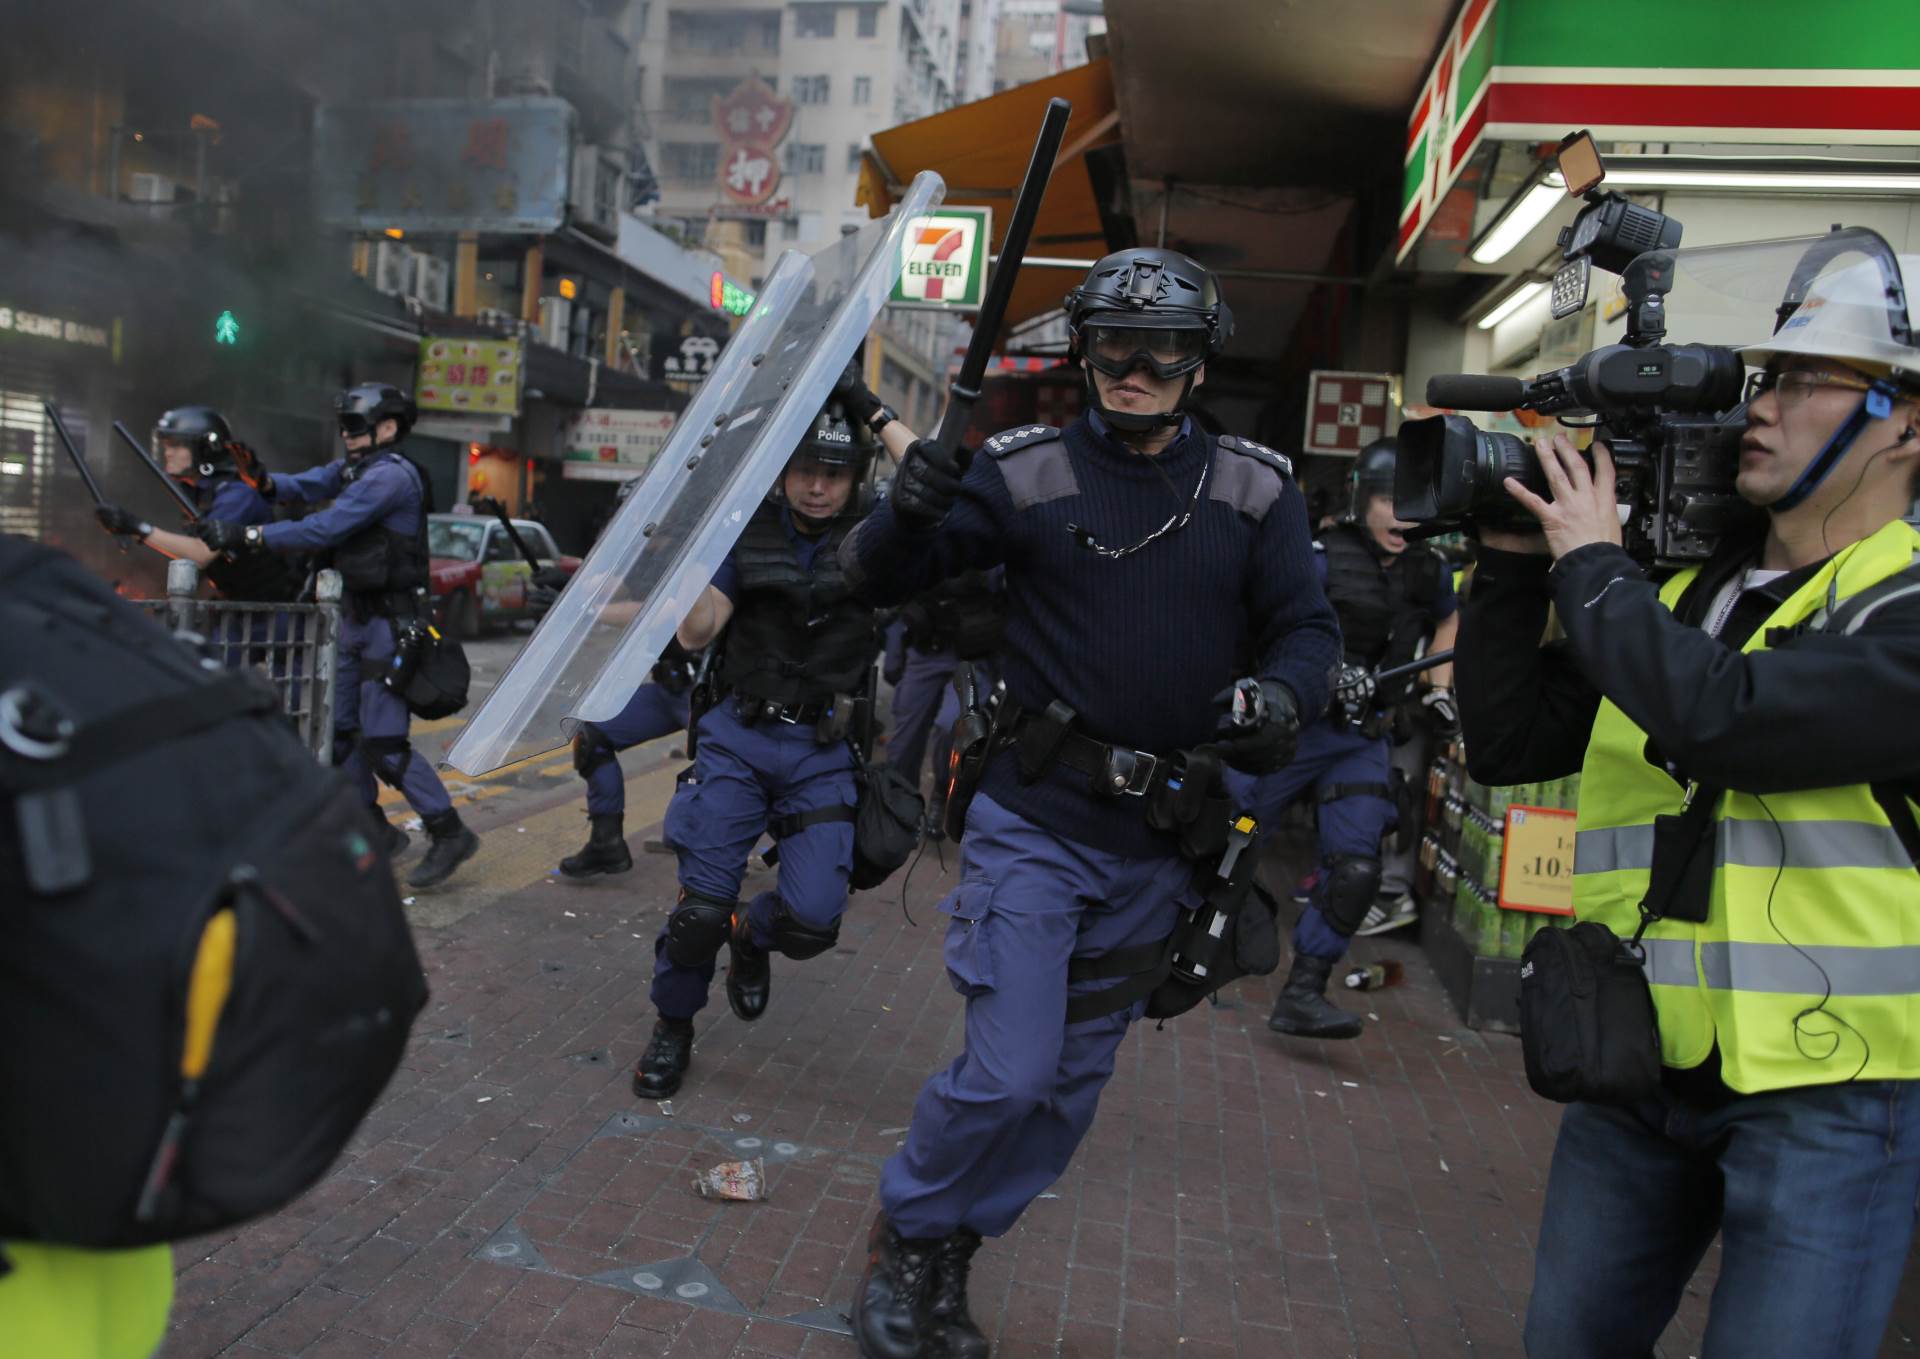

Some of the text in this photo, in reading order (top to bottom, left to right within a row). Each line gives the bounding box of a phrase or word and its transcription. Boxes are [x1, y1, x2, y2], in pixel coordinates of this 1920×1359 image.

[728, 149, 770, 196] 押
[915, 228, 963, 299] 7
[15, 310, 62, 339] SENG
[64, 321, 108, 347] BANK
[817, 430, 851, 443] Police
